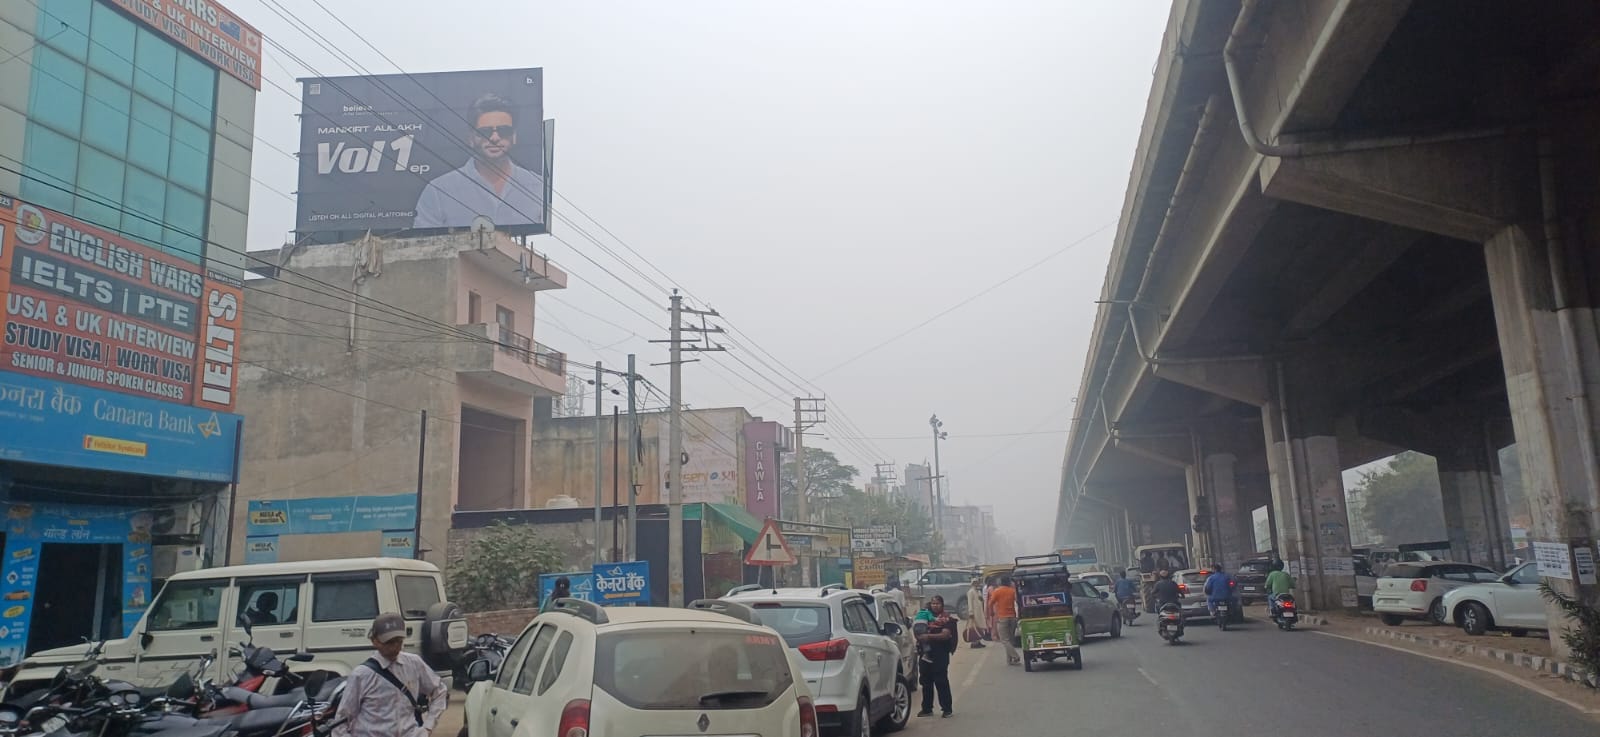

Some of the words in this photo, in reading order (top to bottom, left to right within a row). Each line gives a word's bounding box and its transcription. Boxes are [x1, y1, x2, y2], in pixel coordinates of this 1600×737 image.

[166, 4, 186, 26] UK
[190, 19, 256, 70] INTERVIEW
[172, 0, 217, 27] ARS
[161, 15, 188, 42] VISA
[199, 38, 230, 68] WORK
[232, 60, 255, 83] VISA
[318, 126, 370, 134] MANKIRT
[374, 123, 422, 132] AULAKH
[318, 140, 385, 174] Vol
[410, 164, 430, 175] ep
[353, 211, 376, 219] DIGITAL
[21, 255, 113, 304] IELTS
[138, 293, 189, 327] PTE
[50, 222, 143, 279] ENGLISH
[150, 258, 202, 298] WARS
[5, 321, 63, 354] STUDY
[65, 333, 103, 363] VISA
[116, 345, 160, 377] WORK
[162, 357, 193, 385] VISA
[6, 293, 48, 322] USA
[54, 305, 68, 327] &
[75, 310, 103, 336] UK
[107, 318, 196, 360] INTERVIEW
[202, 290, 238, 405] IELTS
[12, 351, 55, 374] SENIOR
[56, 362, 65, 376] &
[66, 362, 105, 383] JUNIOR
[106, 370, 144, 391] SPOKEN
[145, 377, 185, 401] CLASSES
[93, 398, 154, 428] Canara
[159, 410, 196, 434] Bank
[754, 440, 766, 502] CHAWLA
[596, 574, 626, 592] केनरा
